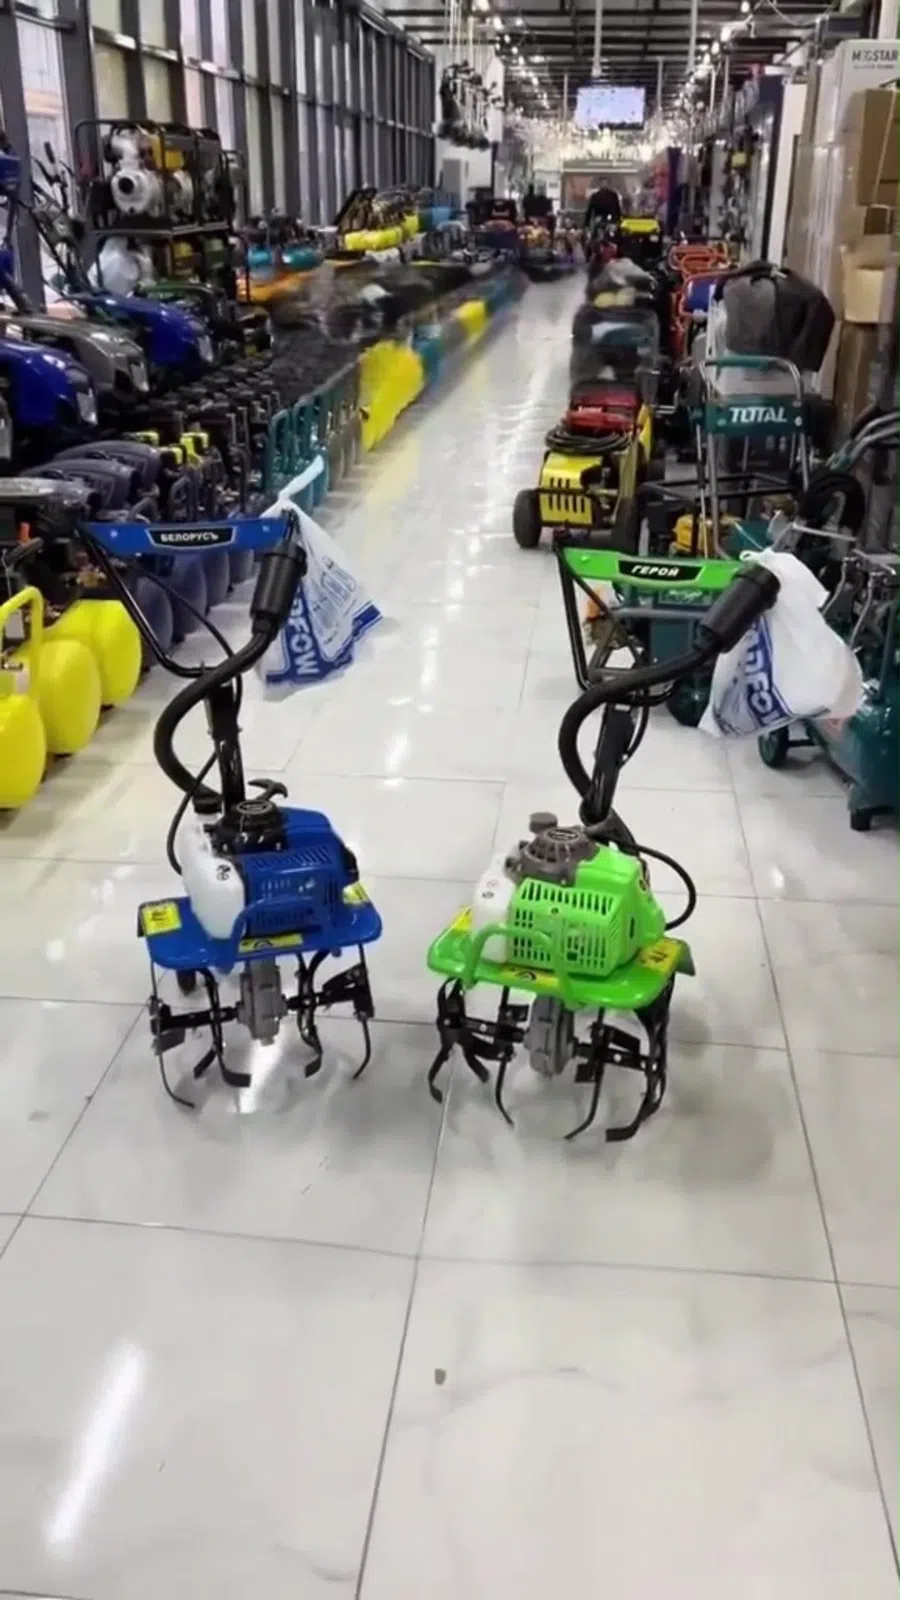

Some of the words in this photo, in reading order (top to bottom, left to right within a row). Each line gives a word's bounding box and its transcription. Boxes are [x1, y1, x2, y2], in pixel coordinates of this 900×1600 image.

[729, 406, 788, 423] TOTAL
[160, 532, 219, 542] БЕЛОРУСЪ
[631, 565, 680, 577] ГЕРОЙ
